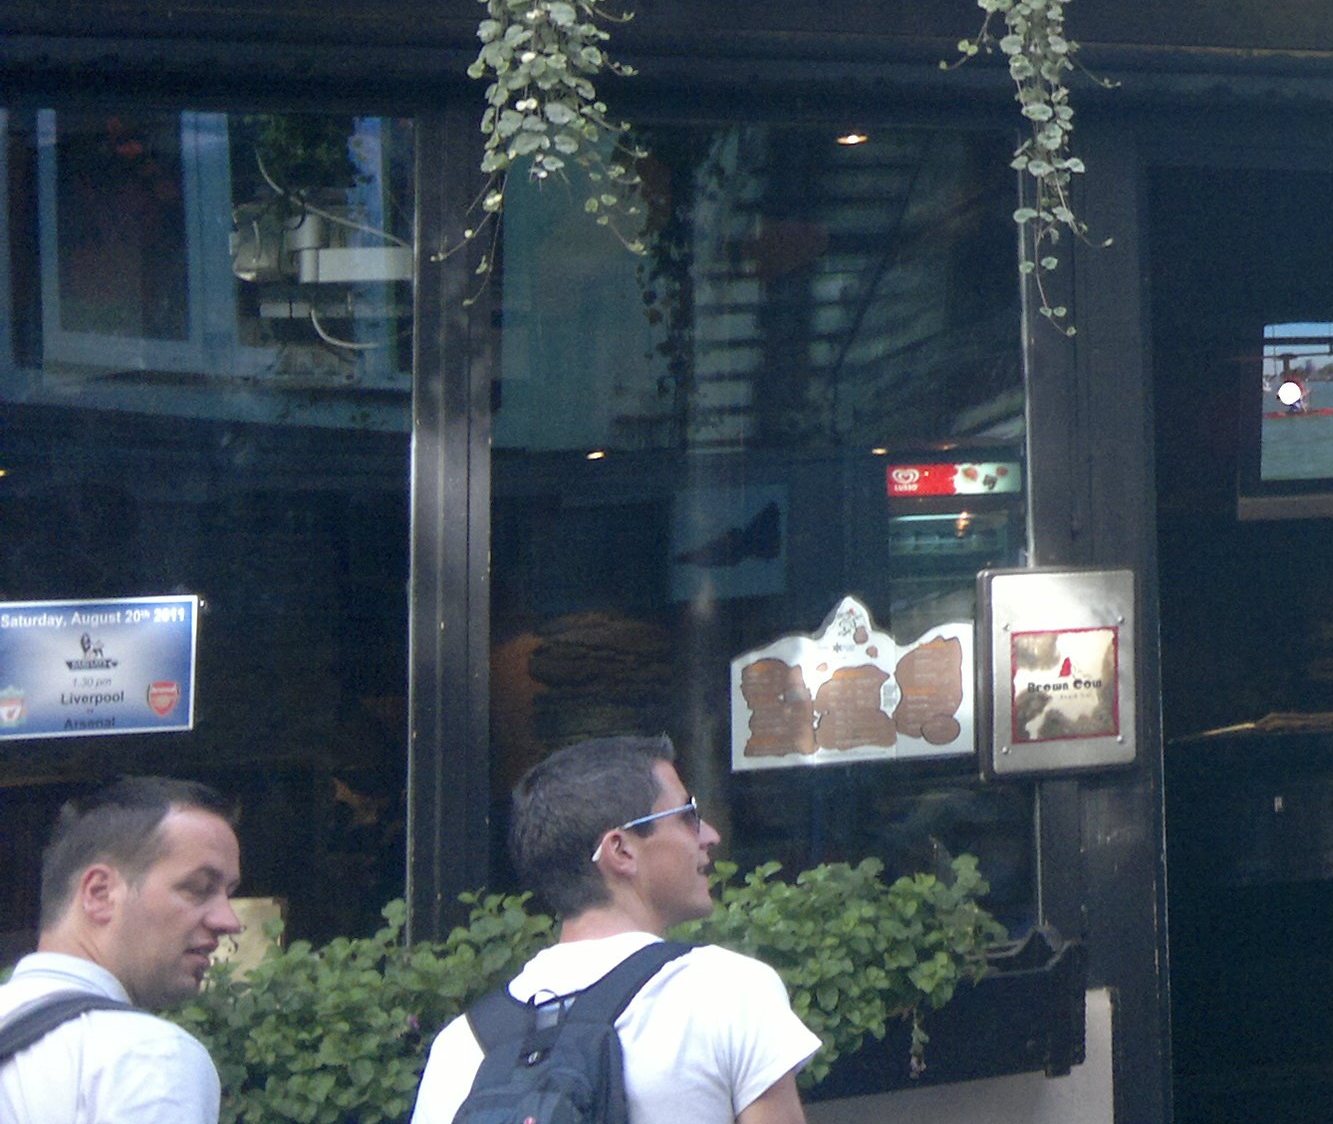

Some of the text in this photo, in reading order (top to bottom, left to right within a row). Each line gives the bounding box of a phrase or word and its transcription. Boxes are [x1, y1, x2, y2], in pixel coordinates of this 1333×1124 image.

[1, 613, 67, 629] Saturday,
[71, 611, 121, 628] August
[154, 607, 186, 623] 2011
[1027, 679, 1102, 694] Brown Cow
[61, 691, 125, 707] Liverpool
[64, 717, 116, 730] Arsenal
